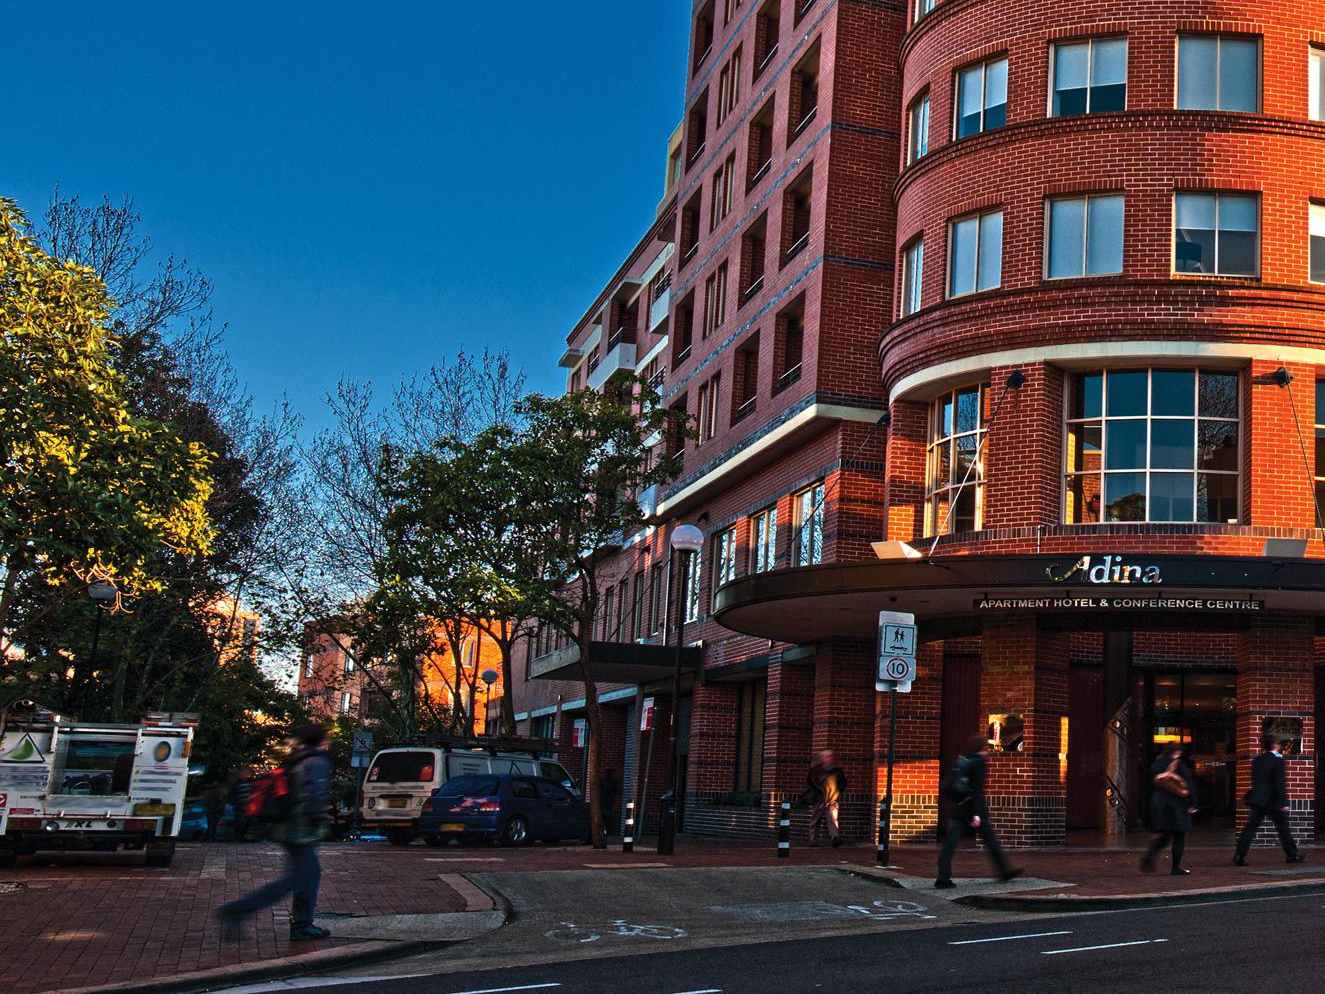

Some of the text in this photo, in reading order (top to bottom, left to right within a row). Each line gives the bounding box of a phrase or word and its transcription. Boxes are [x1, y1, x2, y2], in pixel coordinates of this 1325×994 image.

[1045, 555, 1163, 584] Adina
[980, 598, 1260, 610] APARTMENT HOTEL & CONFERENCE CENTRE
[891, 662, 905, 676] 10
